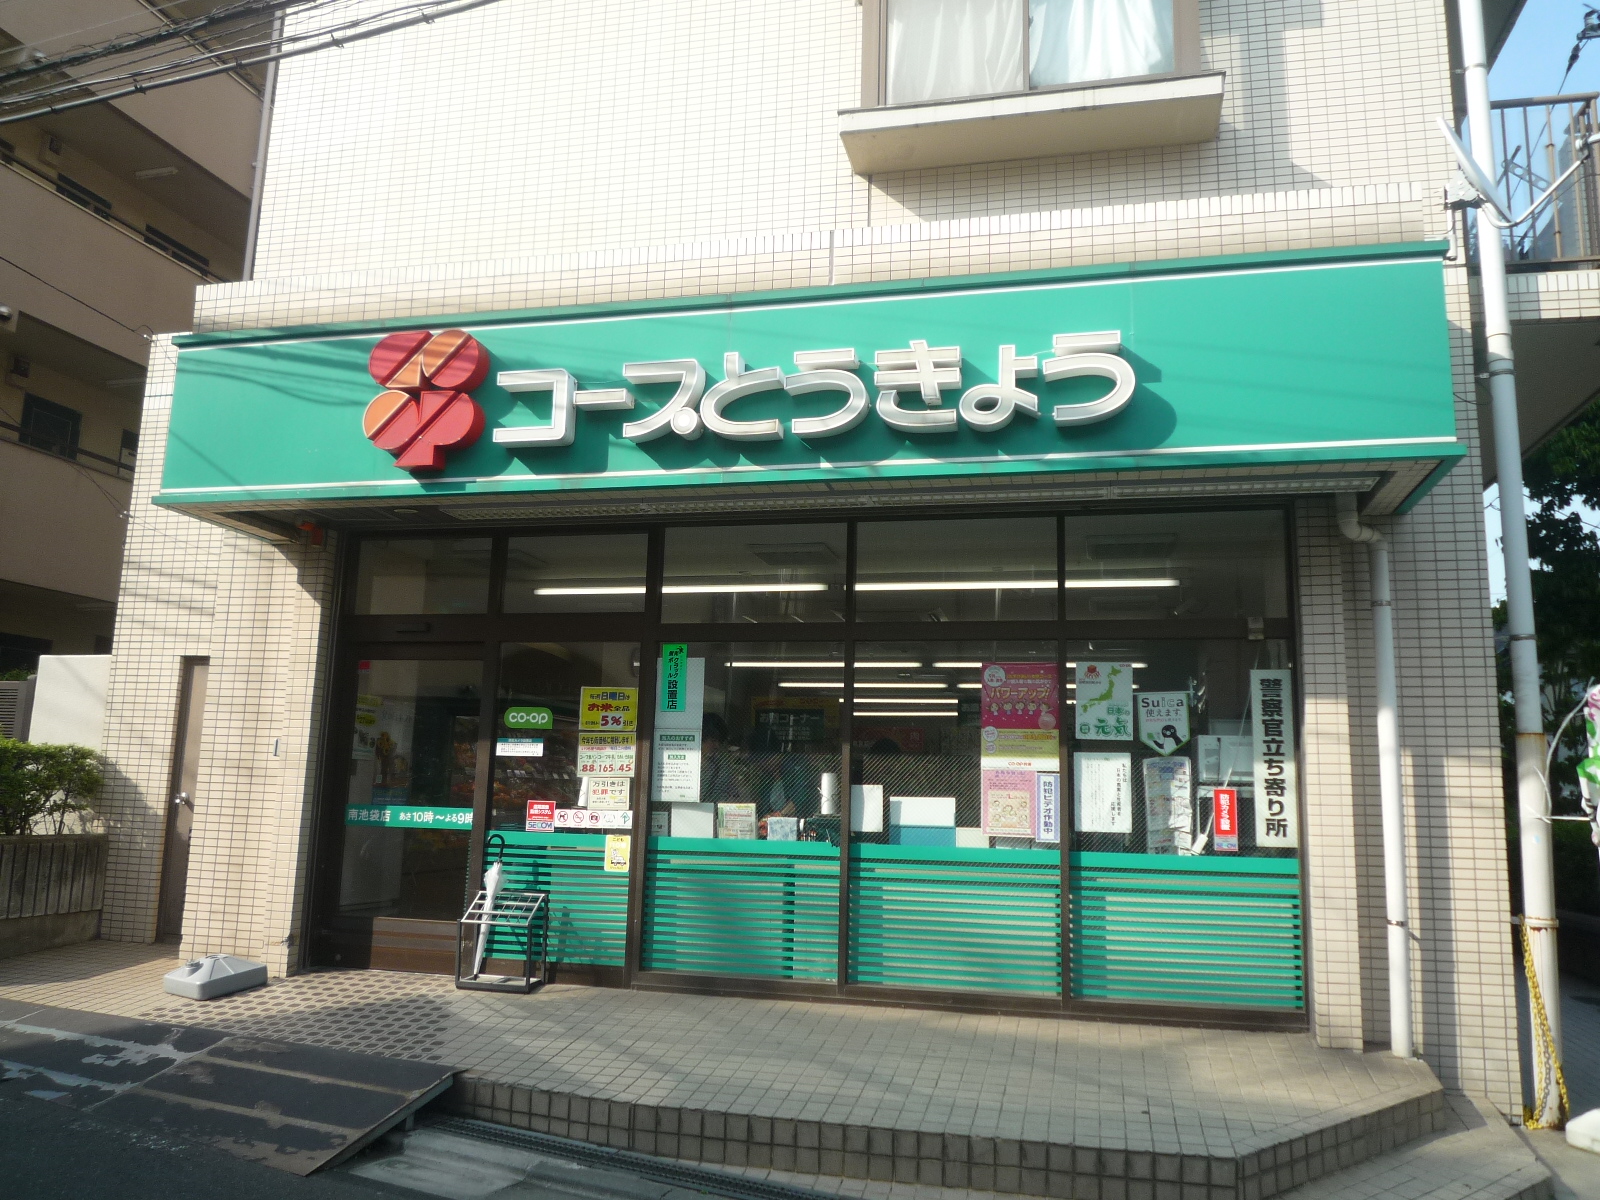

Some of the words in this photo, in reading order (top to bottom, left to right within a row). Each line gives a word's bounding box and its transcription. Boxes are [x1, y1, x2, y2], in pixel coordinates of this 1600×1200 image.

[492, 329, 1137, 448] コープとうきょう
[1141, 696, 1184, 708] Suica
[1094, 716, 1132, 738] 元気
[1259, 678, 1288, 838] 警察官立ち寄り所
[592, 780, 626, 788] 万引きは
[592, 788, 626, 796] 犯罪です
[1043, 780, 1053, 835] 防犯ビデオ作動中
[348, 808, 391, 822] 南池袋店
[528, 821, 553, 829] SECOM
